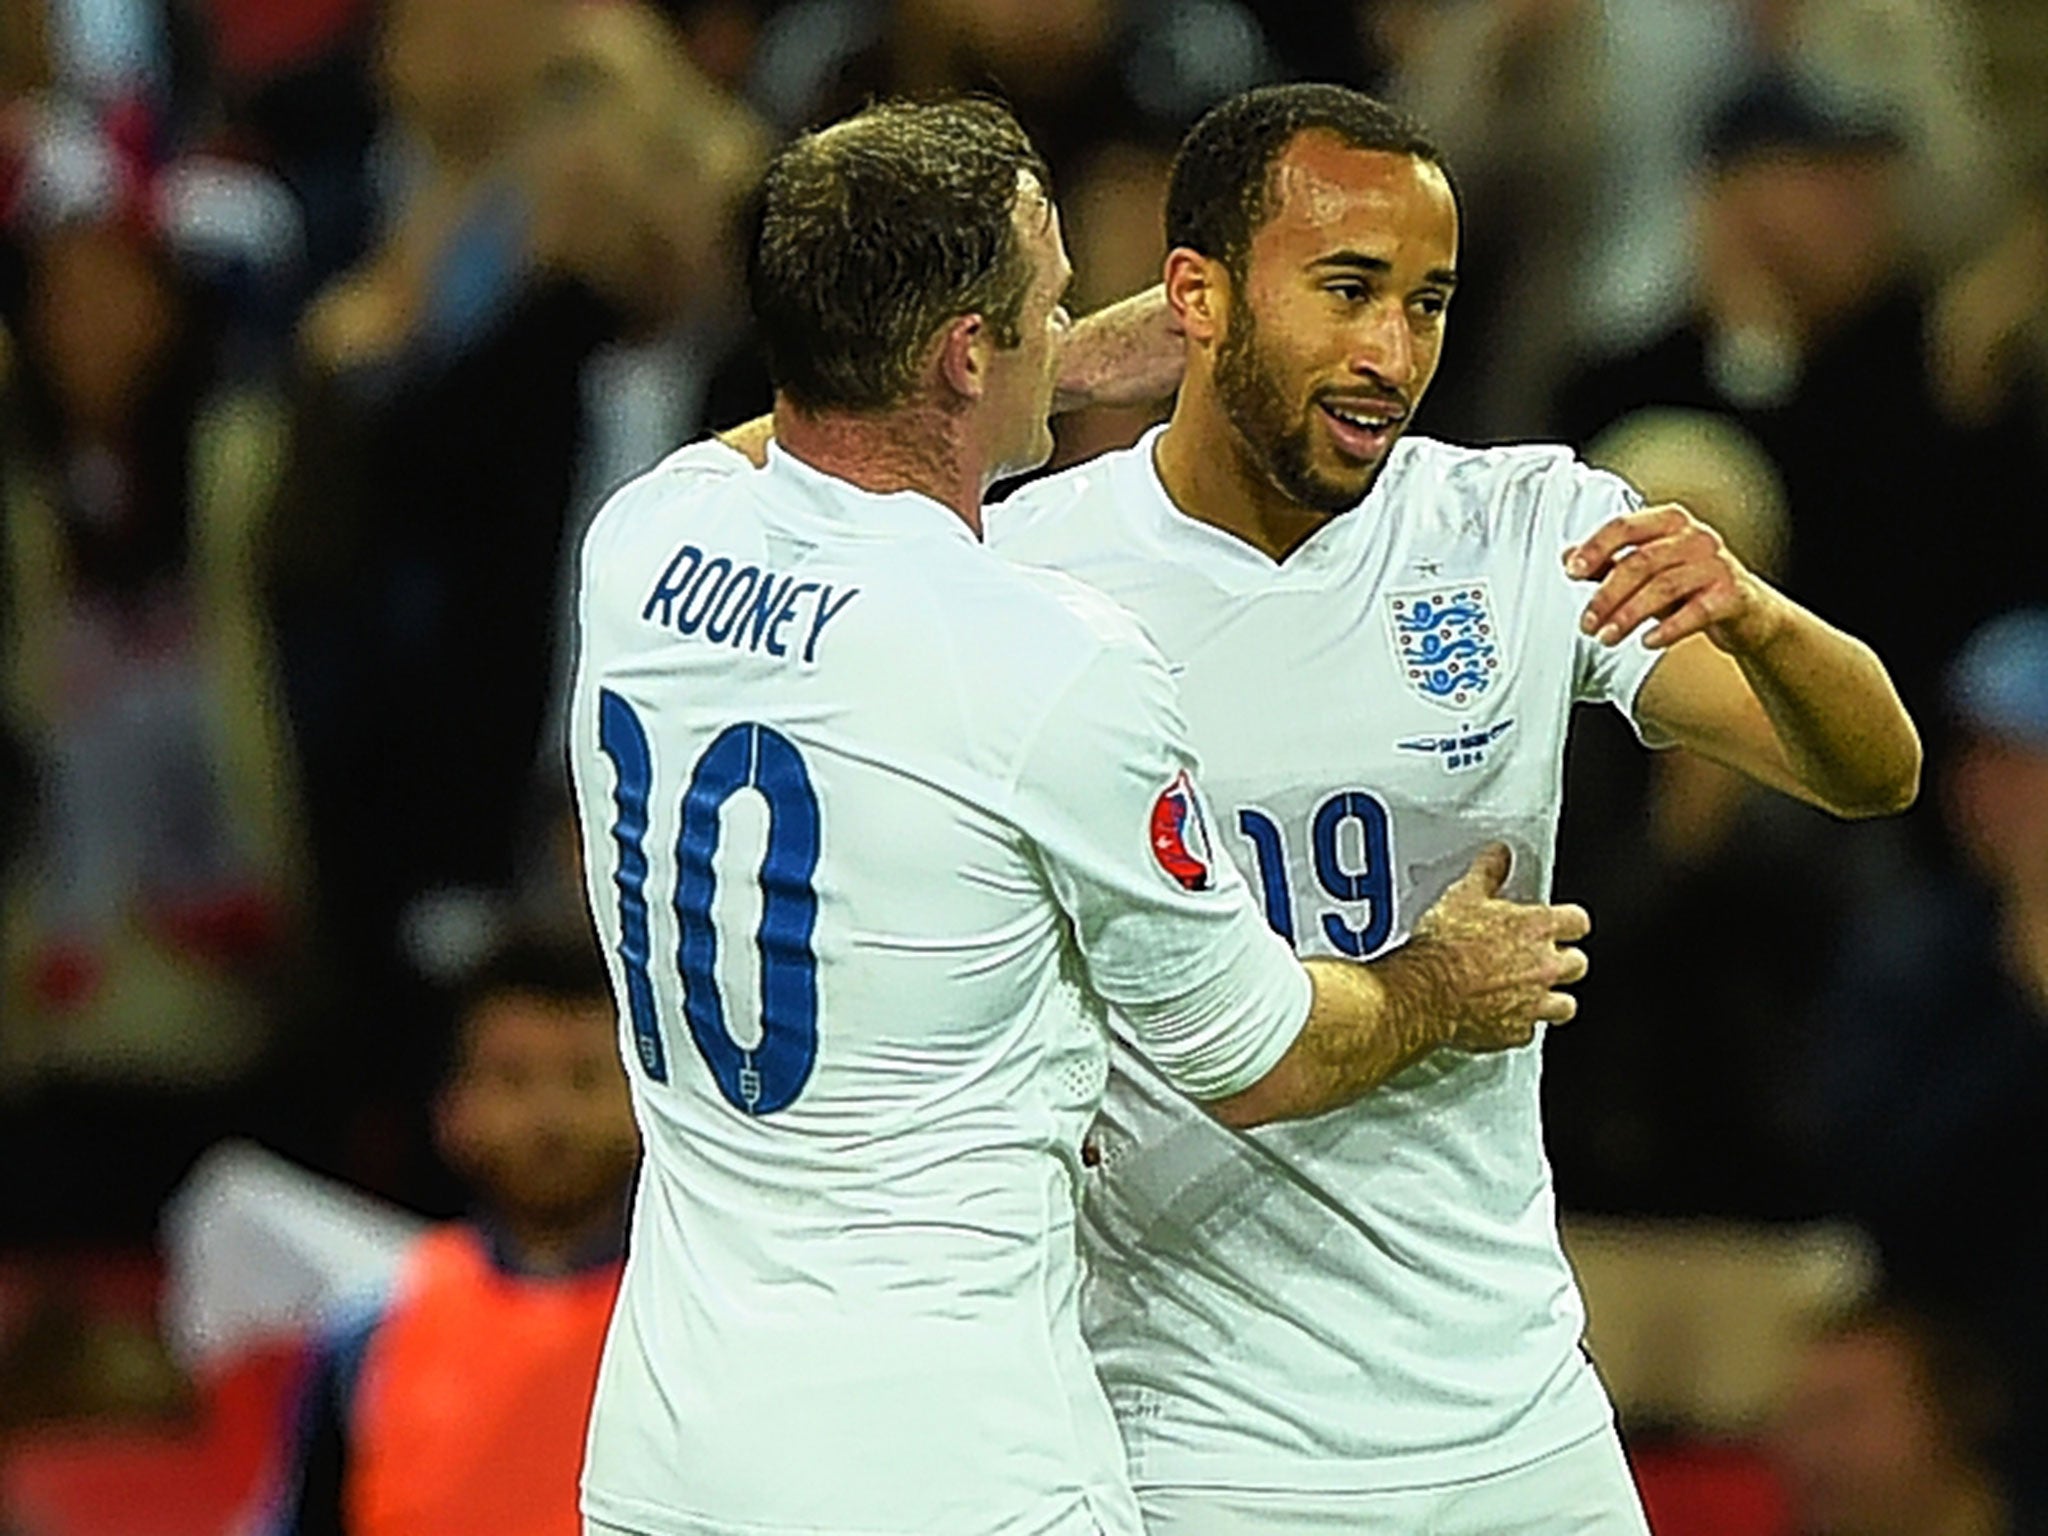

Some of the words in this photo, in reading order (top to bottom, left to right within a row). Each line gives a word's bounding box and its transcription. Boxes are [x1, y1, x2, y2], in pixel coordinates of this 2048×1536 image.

[642, 545, 859, 663] ROONEY
[599, 686, 821, 1115] 10
[1238, 790, 1394, 957] 19
